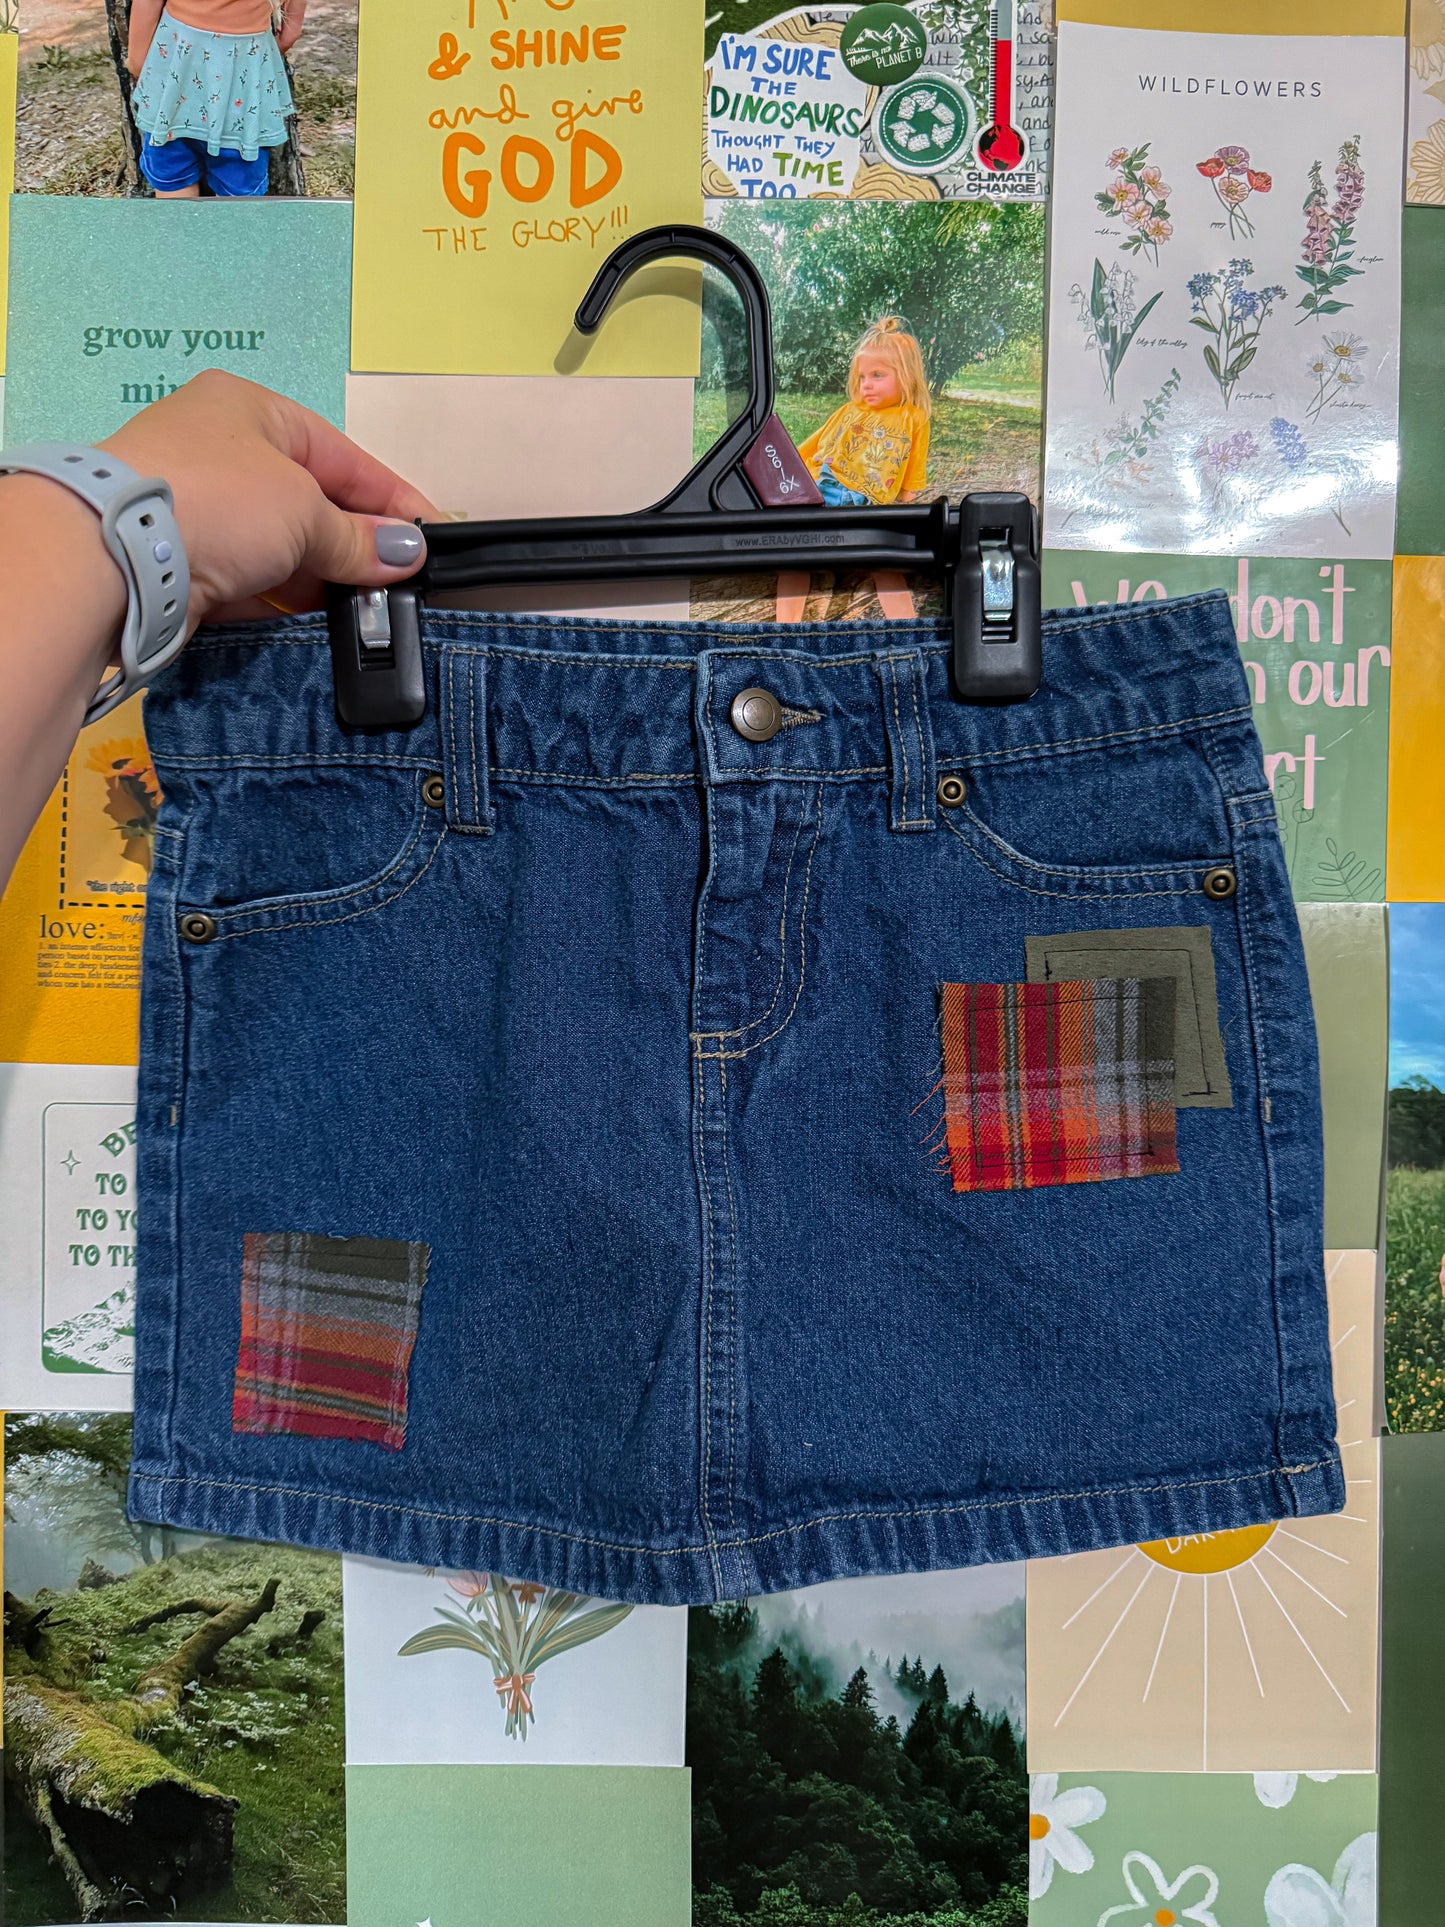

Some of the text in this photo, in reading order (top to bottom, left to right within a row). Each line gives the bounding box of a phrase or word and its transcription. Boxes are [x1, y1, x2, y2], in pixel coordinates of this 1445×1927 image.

[428, 25, 626, 80] & SHINE
[720, 34, 836, 81] I'M SURE
[875, 46, 923, 70] PLANET B
[750, 76, 798, 96] THE
[1138, 74, 1323, 98] WILDFLOWERS
[429, 84, 644, 142] and give
[711, 85, 864, 139] DINOSAURS
[711, 129, 790, 149] THOUGHT
[794, 136, 836, 160] THEY
[442, 129, 623, 218] GOD
[727, 152, 845, 187] HAD TIME
[966, 171, 1036, 183] CLIMATE
[740, 179, 798, 199] TOO
[966, 182, 1036, 194] CHANGE
[422, 227, 488, 254] THE
[82, 325, 266, 358] grow your
[1229, 558, 1356, 645] don't
[1288, 645, 1392, 708] our
[40, 914, 105, 939] love:
[95, 1173, 128, 1196] TO
[76, 1208, 109, 1231] TO
[68, 1244, 101, 1267] TO
